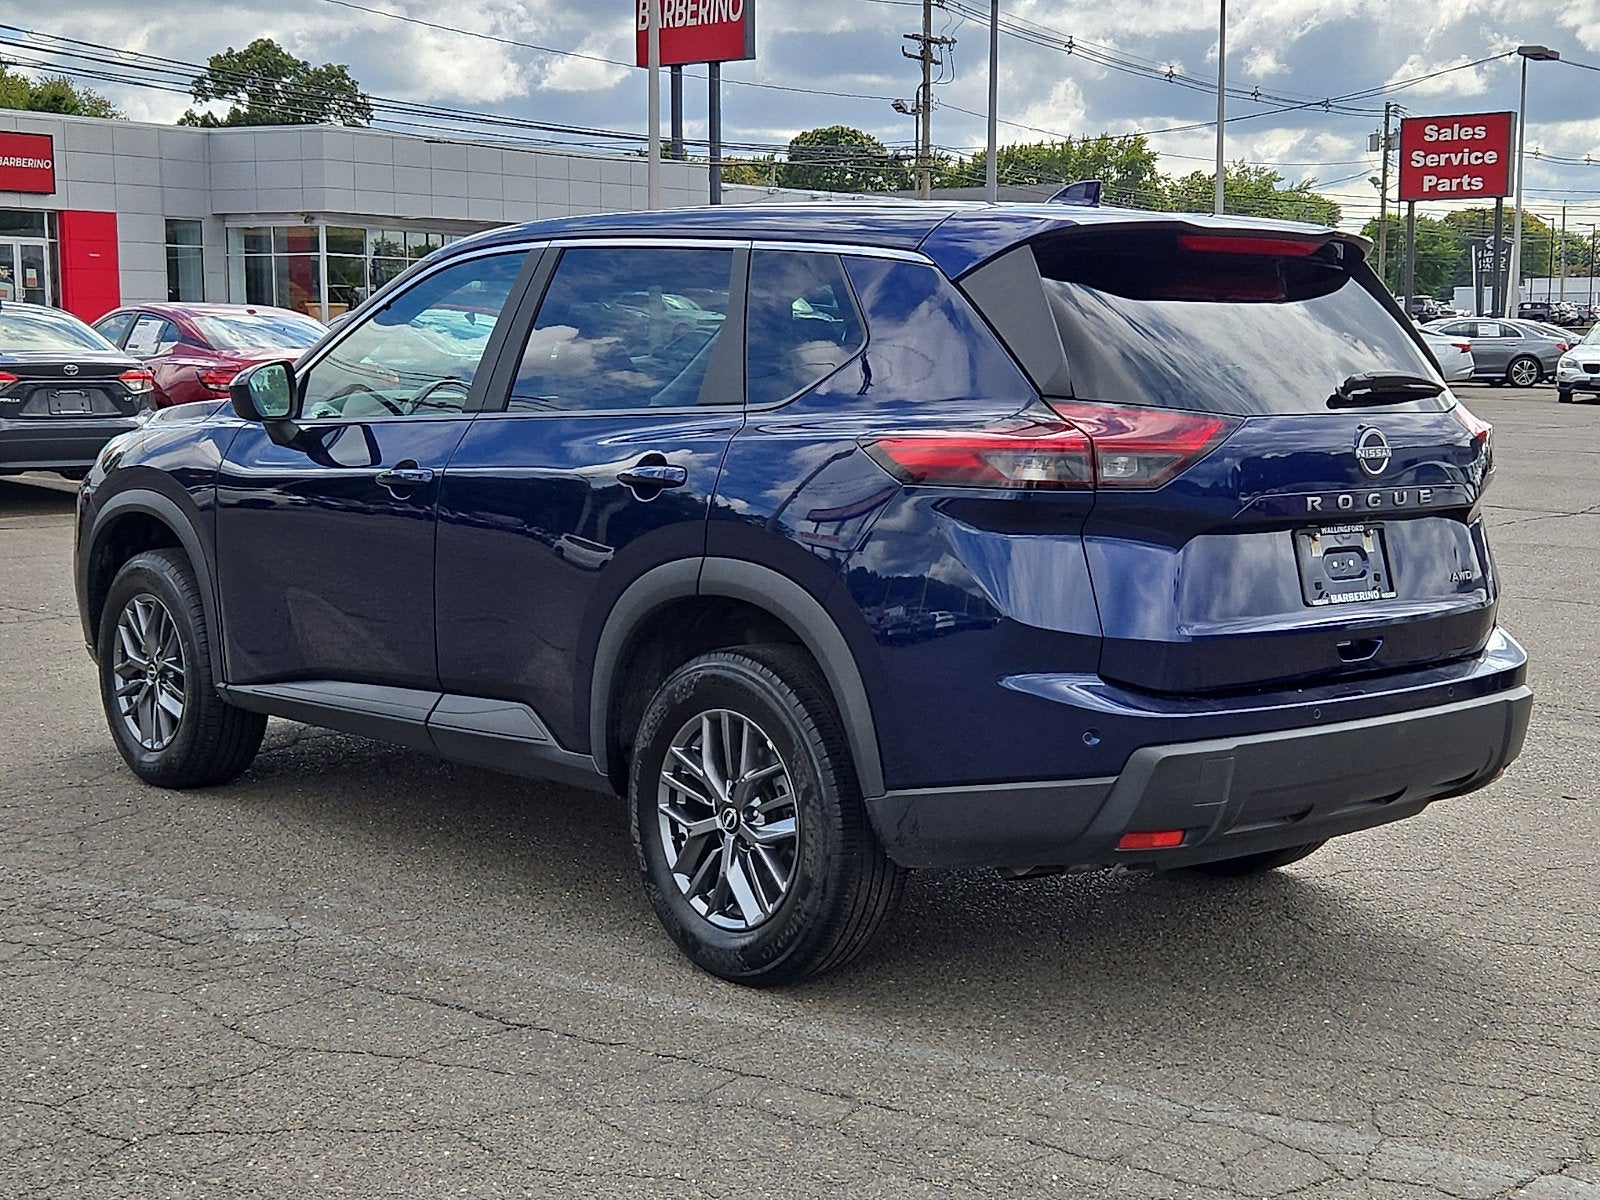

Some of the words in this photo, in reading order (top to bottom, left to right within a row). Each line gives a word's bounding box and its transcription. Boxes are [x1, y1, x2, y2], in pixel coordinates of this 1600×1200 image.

[1423, 123, 1486, 142] Sales
[1410, 148, 1498, 168] Service
[1422, 174, 1484, 192] Parts
[1357, 448, 1391, 458] NISSAN
[1306, 489, 1433, 511] ROGUE
[1320, 524, 1365, 535] WALLINGFORD
[1451, 570, 1472, 581] AWD
[1330, 590, 1379, 604] BARBERINO
